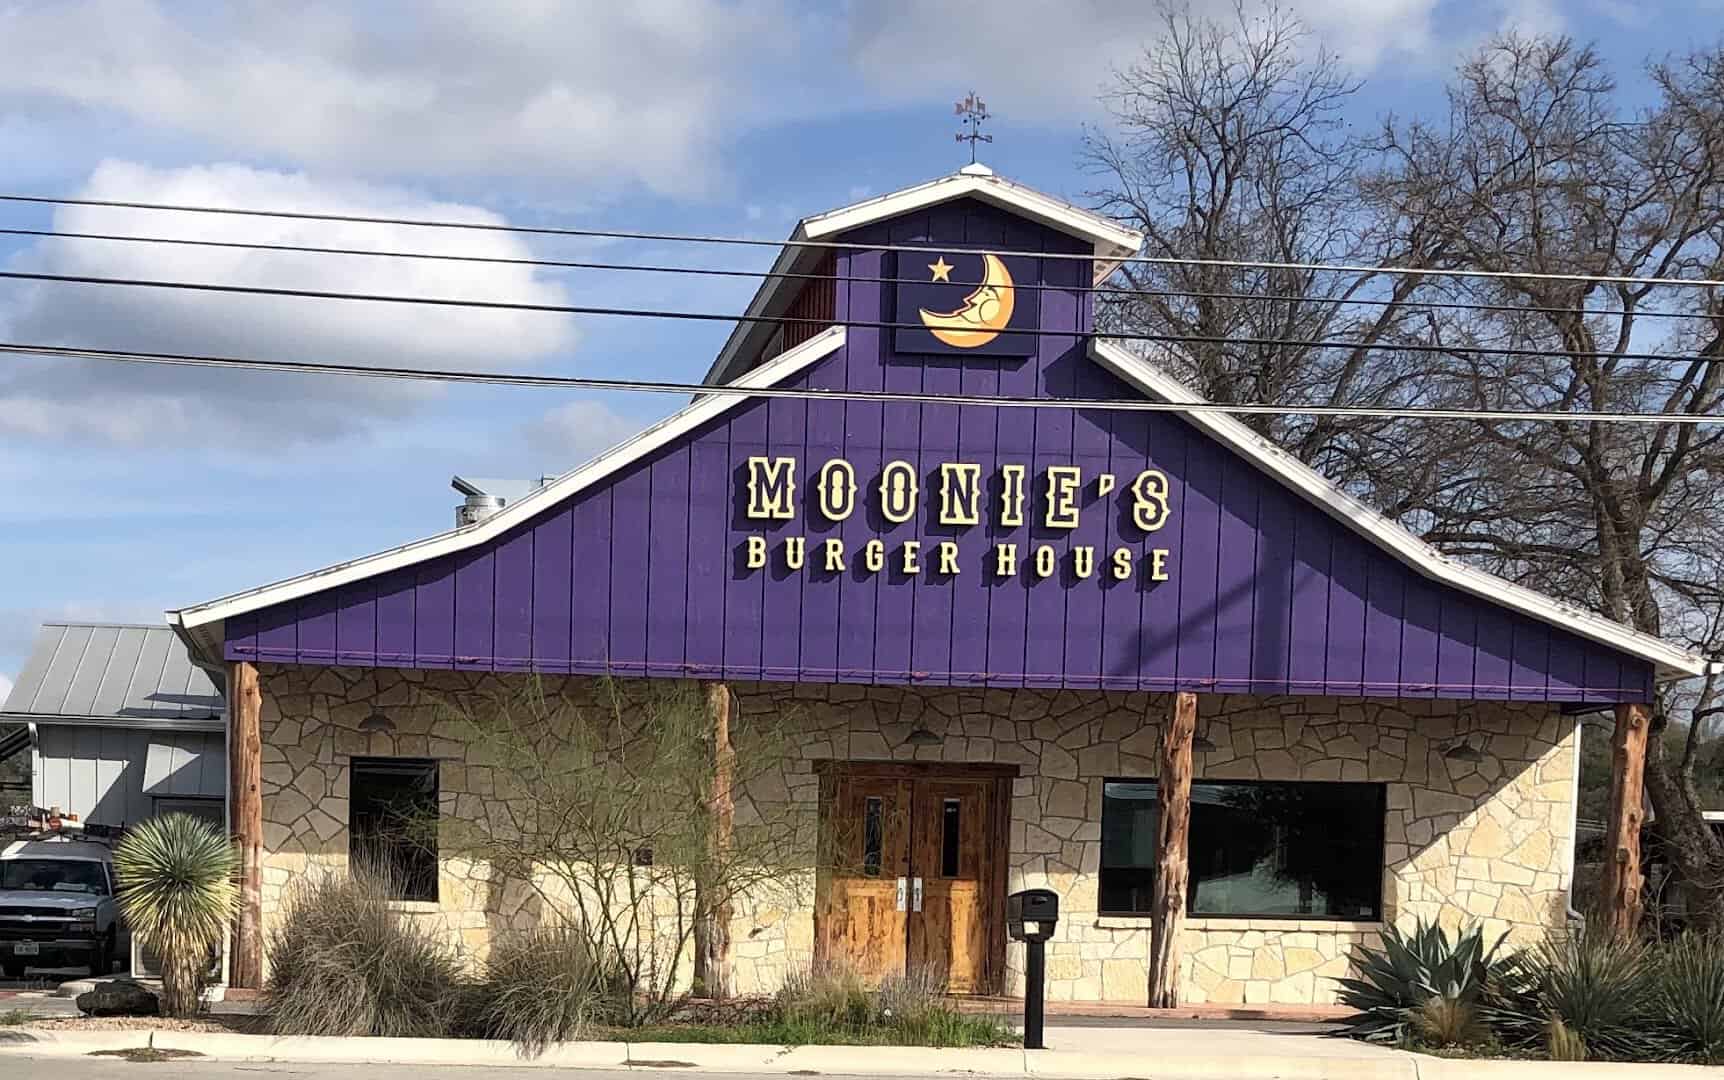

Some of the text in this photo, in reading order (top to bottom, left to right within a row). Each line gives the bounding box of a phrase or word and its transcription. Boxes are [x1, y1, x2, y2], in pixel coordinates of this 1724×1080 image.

[747, 456, 1171, 531] MOONIE'S
[747, 536, 1170, 581] BURGER HOUSE
